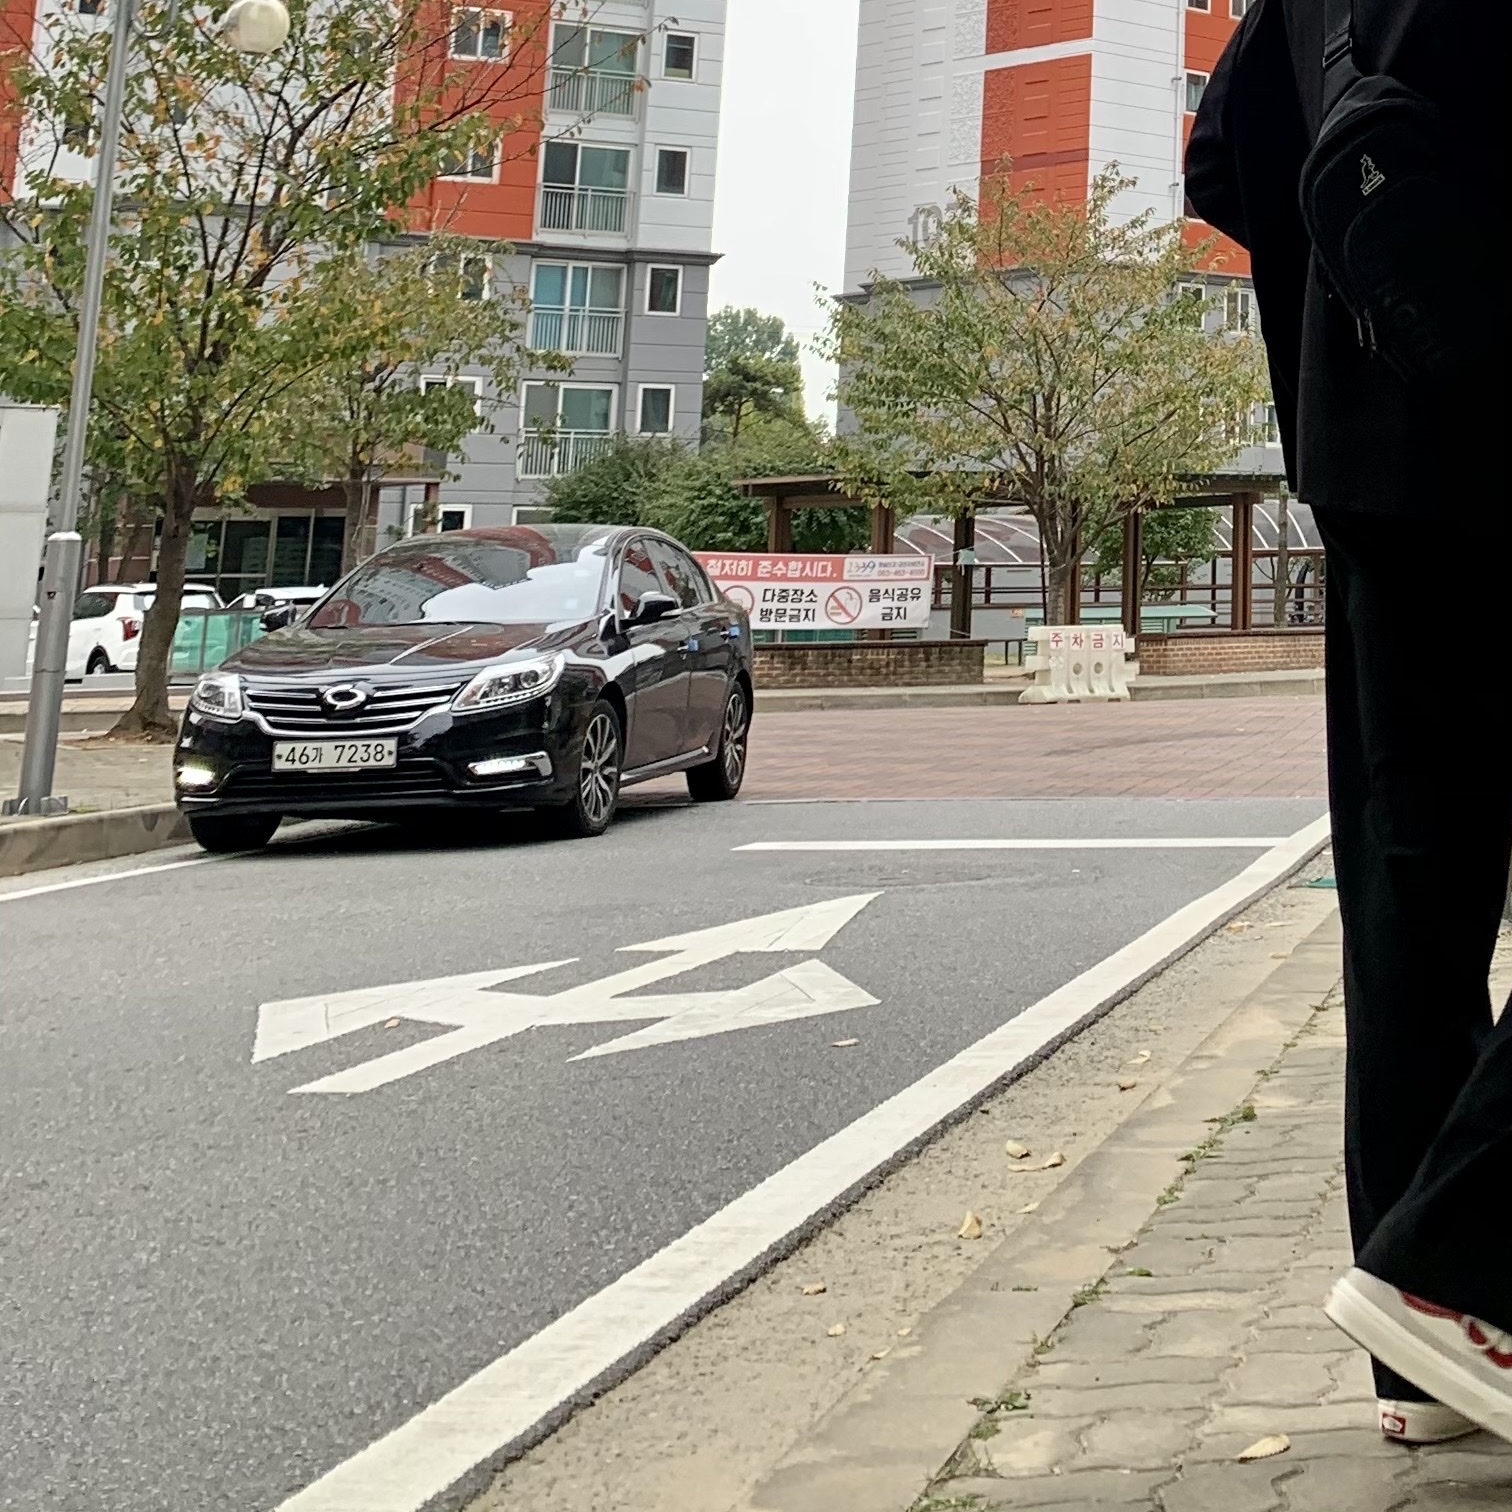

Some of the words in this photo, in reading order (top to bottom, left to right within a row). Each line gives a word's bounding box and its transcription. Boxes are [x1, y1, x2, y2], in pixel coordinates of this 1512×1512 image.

[706, 559, 752, 576] 철저히
[757, 560, 837, 578] 준수합시다.
[762, 588, 818, 604] 다중장소
[868, 588, 921, 603] 음식공유
[759, 607, 816, 623] 방문금지
[881, 607, 907, 621] 금지
[284, 746, 323, 765] 46가
[334, 743, 385, 764] 7238
